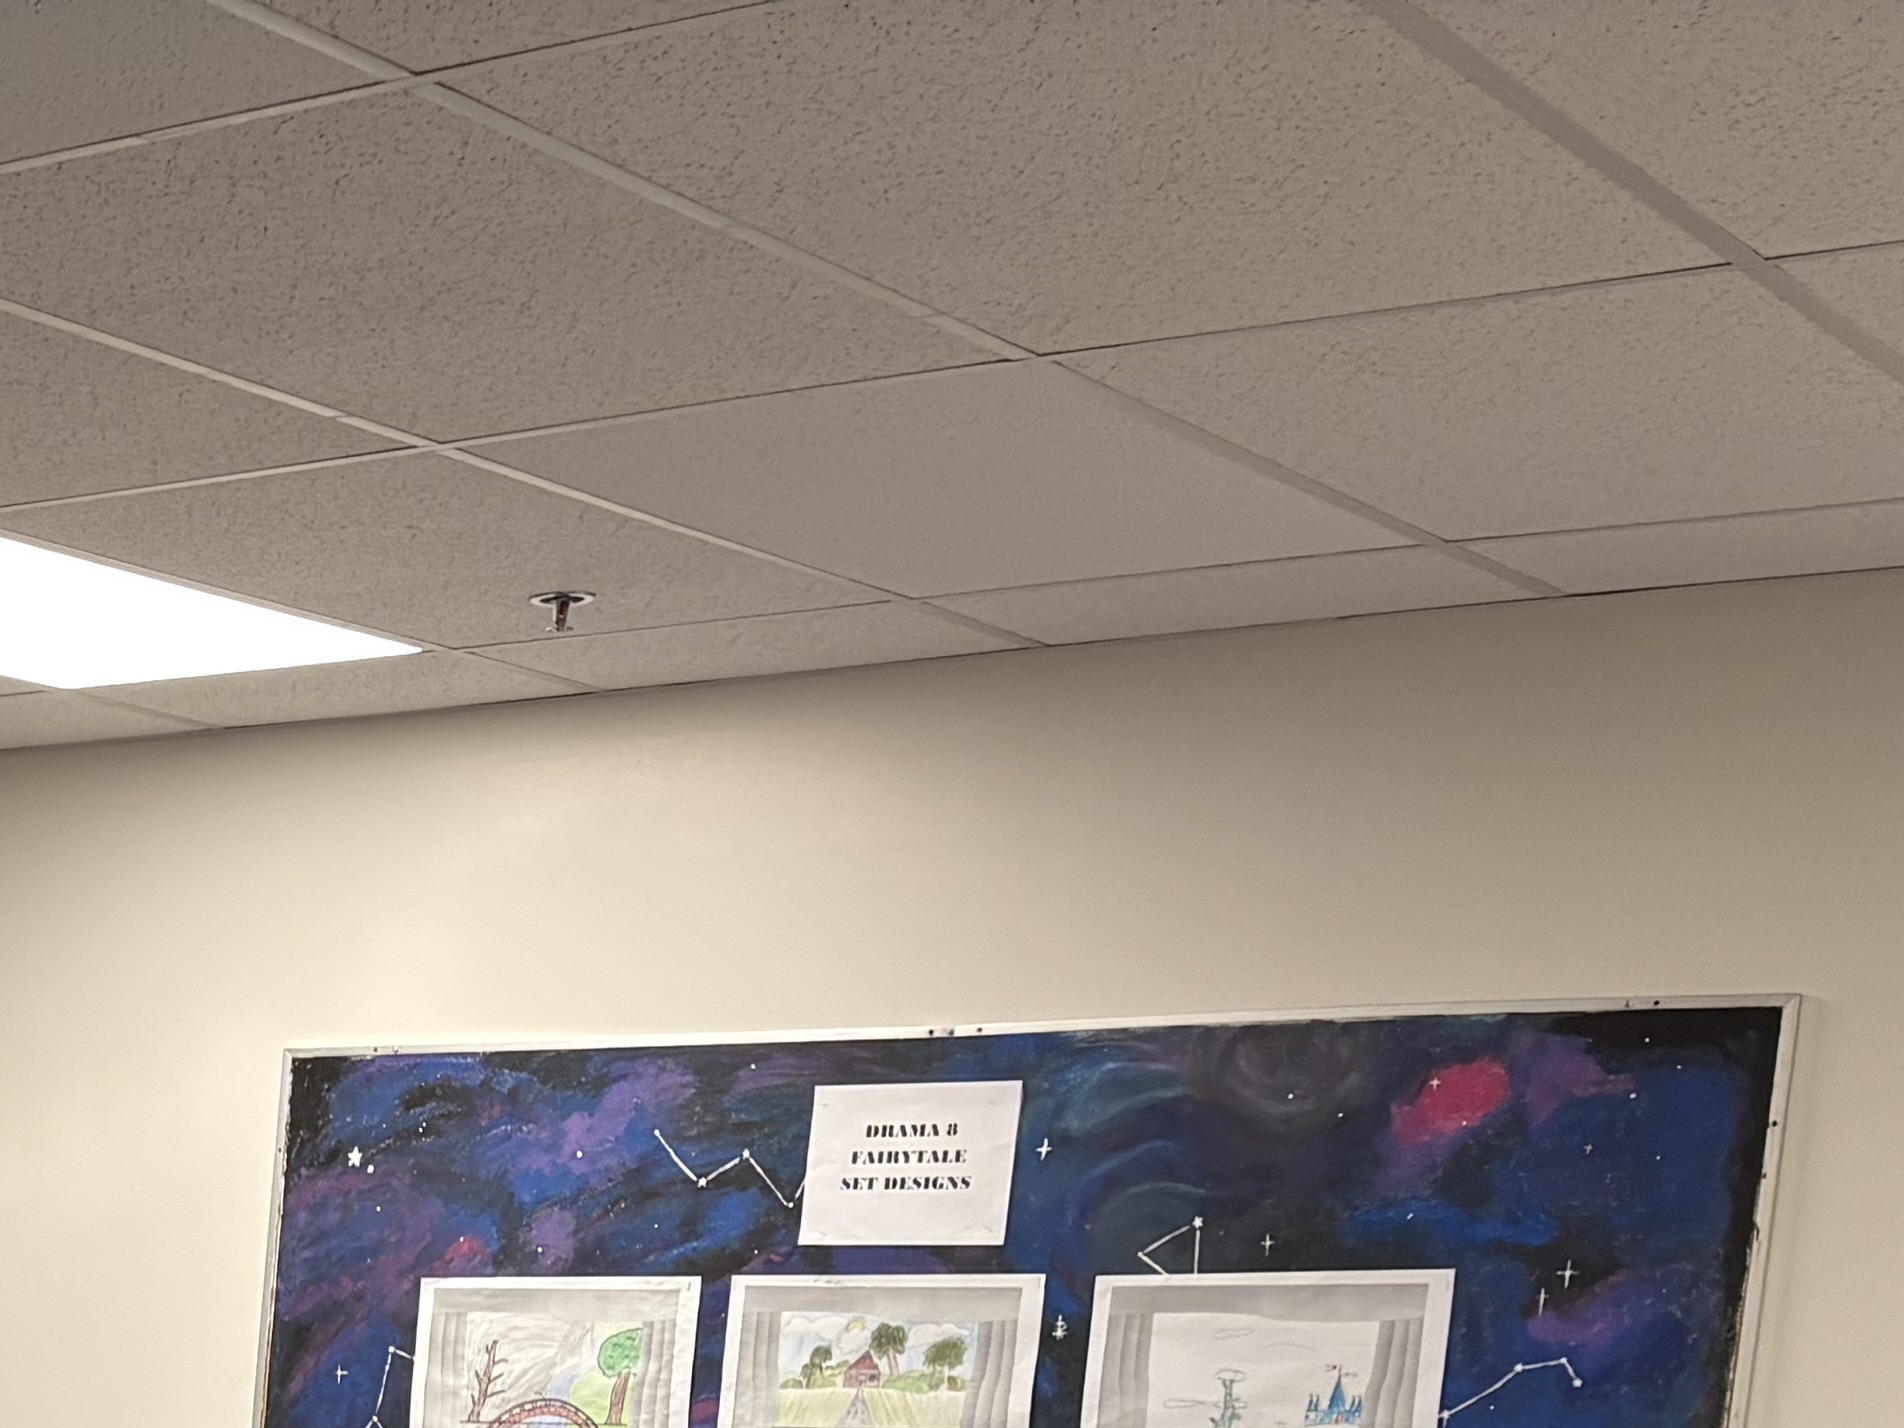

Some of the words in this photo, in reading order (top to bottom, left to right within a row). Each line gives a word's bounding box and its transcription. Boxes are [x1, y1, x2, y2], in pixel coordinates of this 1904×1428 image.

[866, 1123, 939, 1138] DRAMA
[946, 1122, 958, 1136] 8
[851, 1149, 968, 1165] FAIRYTALE
[840, 1177, 878, 1190] SET
[884, 1176, 972, 1190] DESIGNS
